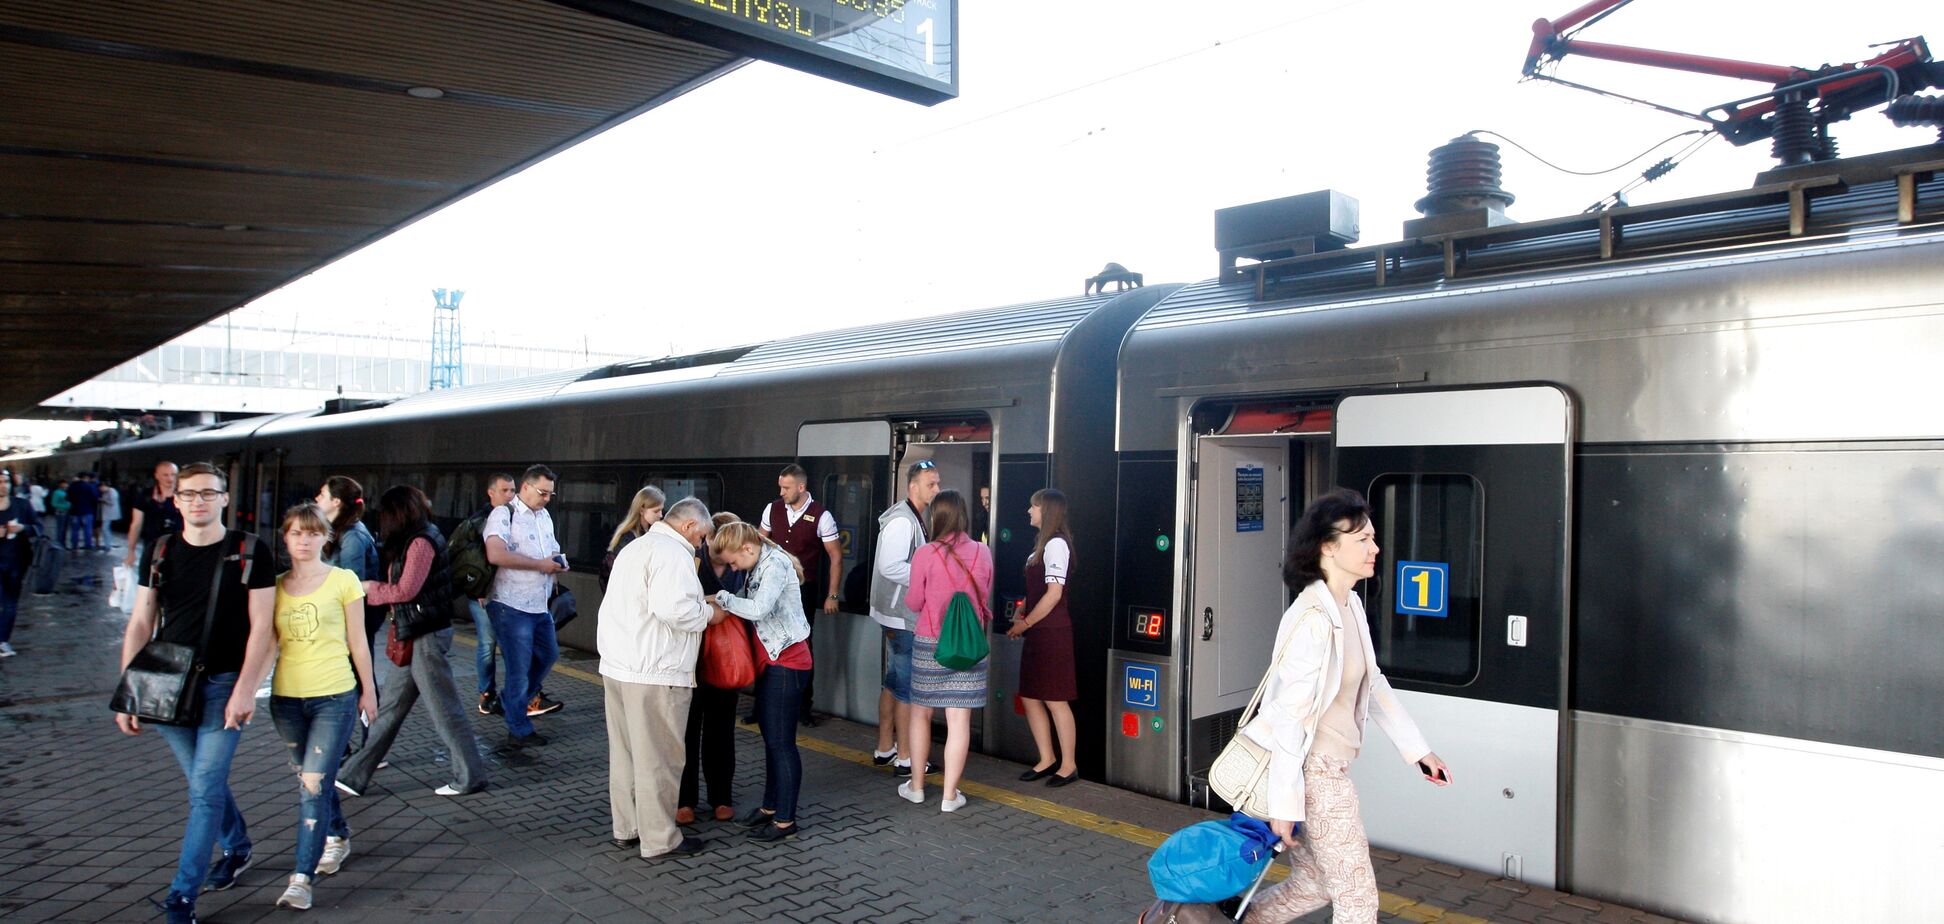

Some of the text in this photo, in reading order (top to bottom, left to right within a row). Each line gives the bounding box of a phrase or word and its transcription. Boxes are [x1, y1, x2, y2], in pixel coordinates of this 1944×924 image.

[916, 17, 934, 65] 1
[1411, 571, 1429, 607] 1
[1129, 677, 1153, 692] WI-FI
